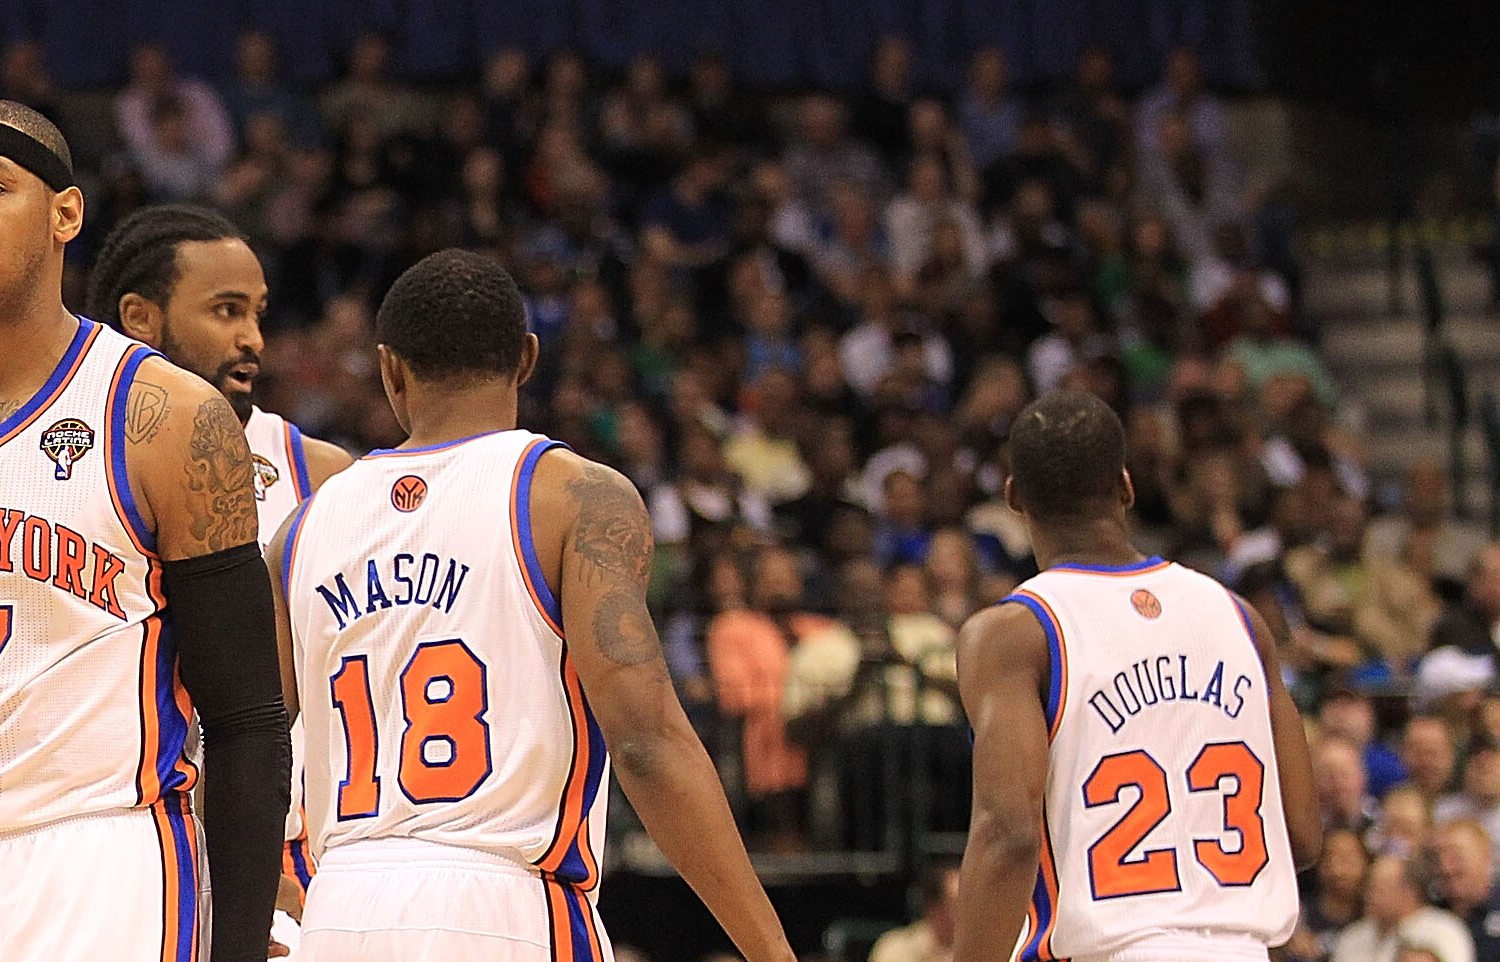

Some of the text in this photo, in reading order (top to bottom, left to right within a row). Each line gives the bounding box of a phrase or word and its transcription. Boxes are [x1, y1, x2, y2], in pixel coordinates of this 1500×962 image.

[44, 437, 91, 446] LATINA
[46, 431, 90, 440] NOCHE
[315, 553, 469, 631] MASON
[329, 638, 493, 822] 18
[1088, 655, 1252, 734] DOUGLAS
[1082, 741, 1269, 901] 23
